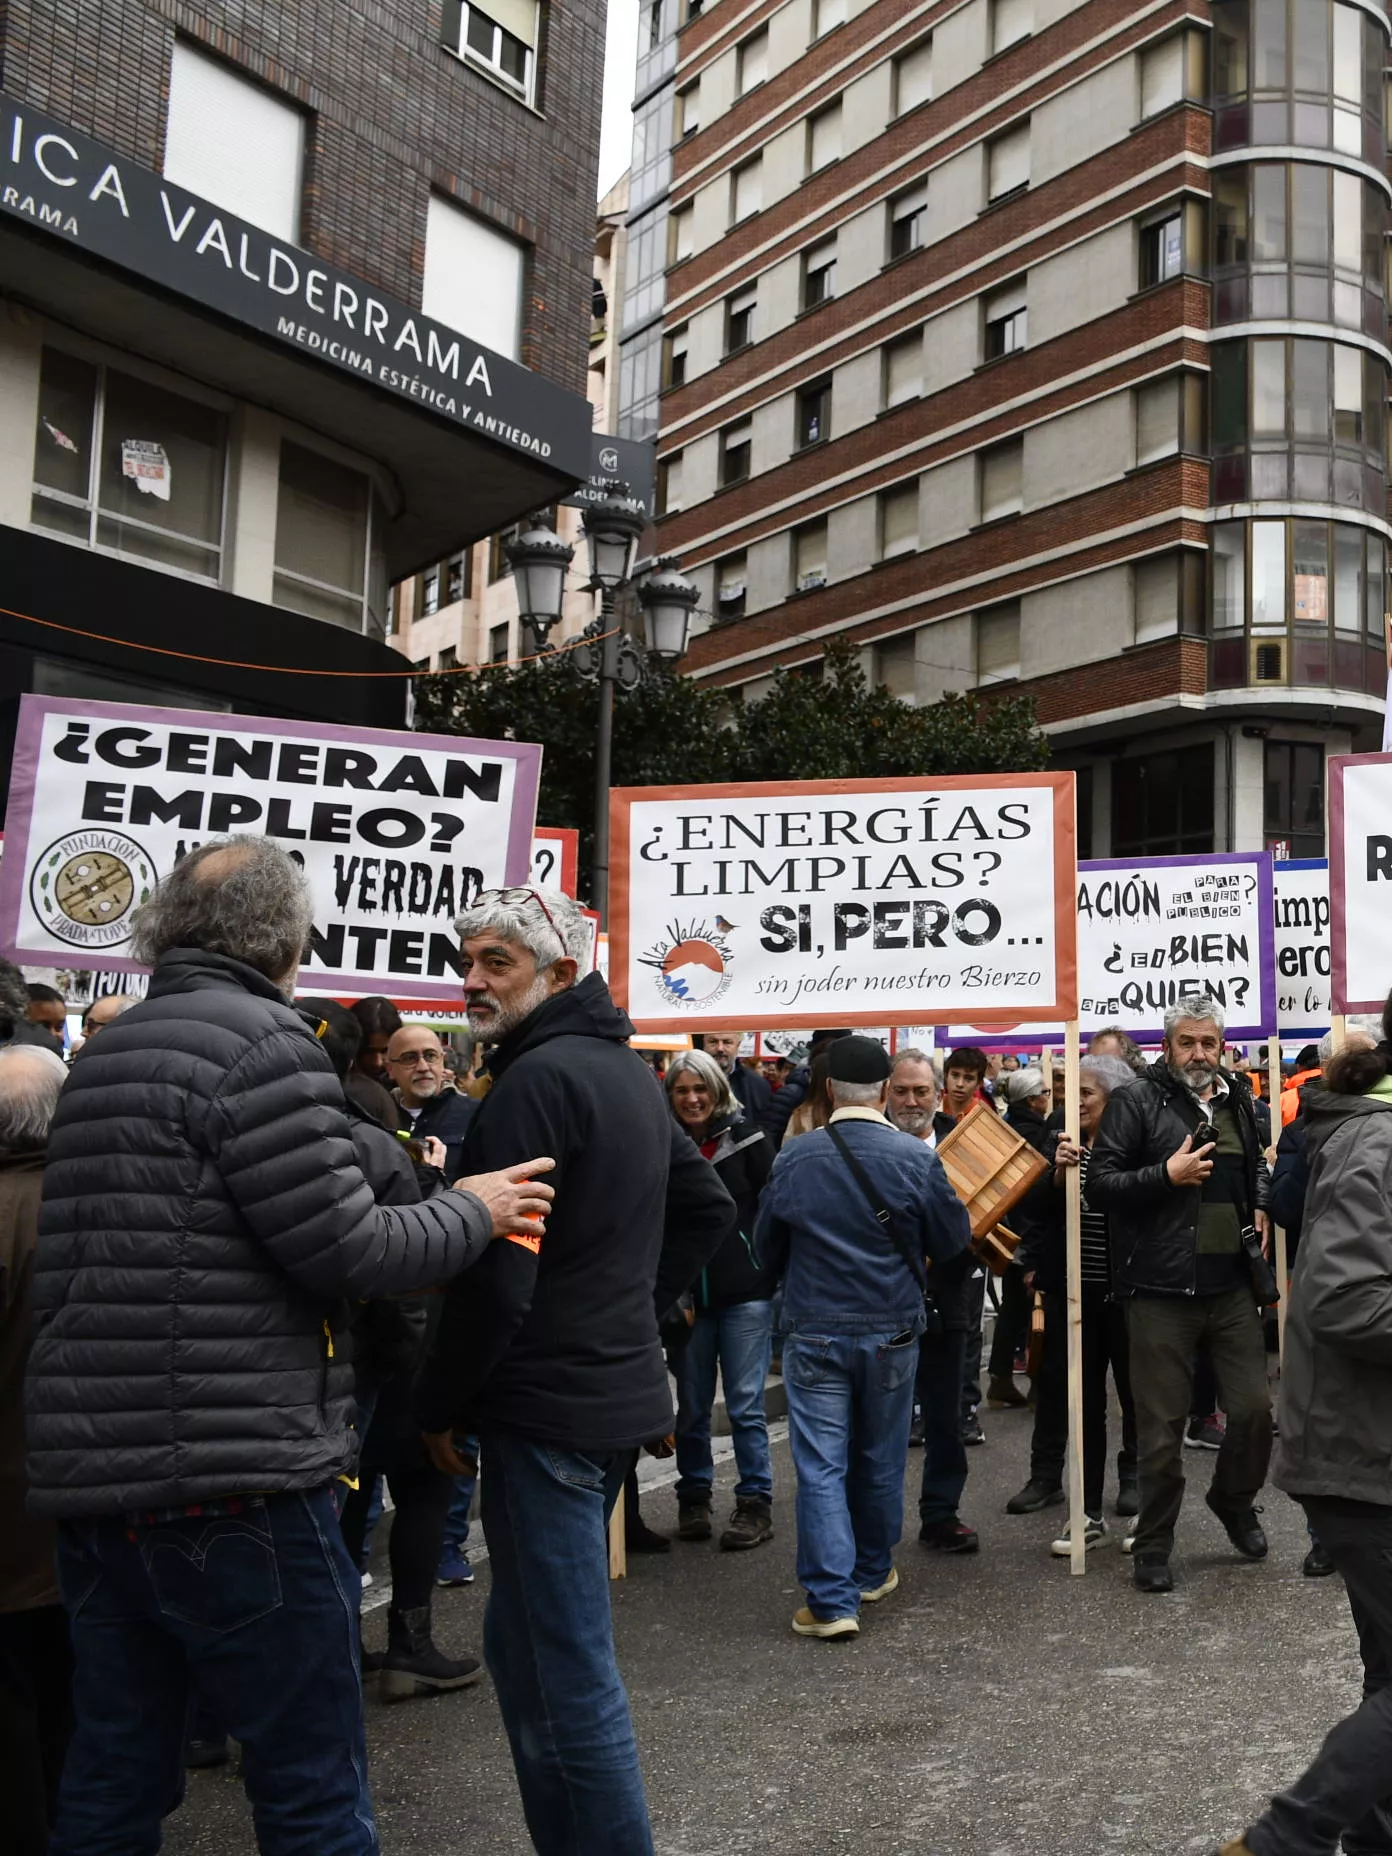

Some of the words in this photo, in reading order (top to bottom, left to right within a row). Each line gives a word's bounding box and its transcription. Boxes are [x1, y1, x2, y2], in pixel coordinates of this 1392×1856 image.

[0, 184, 79, 236] RAMA
[160, 190, 493, 397] VALDERRAMA
[277, 316, 374, 375] MEDICINA
[379, 365, 456, 414] ESTÉTICA
[461, 403, 472, 420] Y
[474, 410, 552, 458] ANTIEDAD
[53, 721, 502, 803] ¿GENERAN
[81, 780, 465, 853] EMPLEO?
[640, 797, 1032, 862] ¿ENERGÍAS
[333, 854, 484, 920] VERDAD
[670, 850, 1003, 897] LIMPIAS?
[1077, 873, 1162, 922] ACIÓN
[1172, 891, 1194, 905] EL
[1202, 890, 1240, 903] BIEN
[1194, 875, 1240, 889] PARA
[636, 940, 674, 971] Alta
[1168, 933, 1250, 970] BIEN
[1275, 945, 1331, 977] ero
[754, 974, 789, 995] sin
[779, 965, 858, 1006] joder
[863, 967, 952, 992] nuestro
[960, 964, 1042, 989] Bierzo
